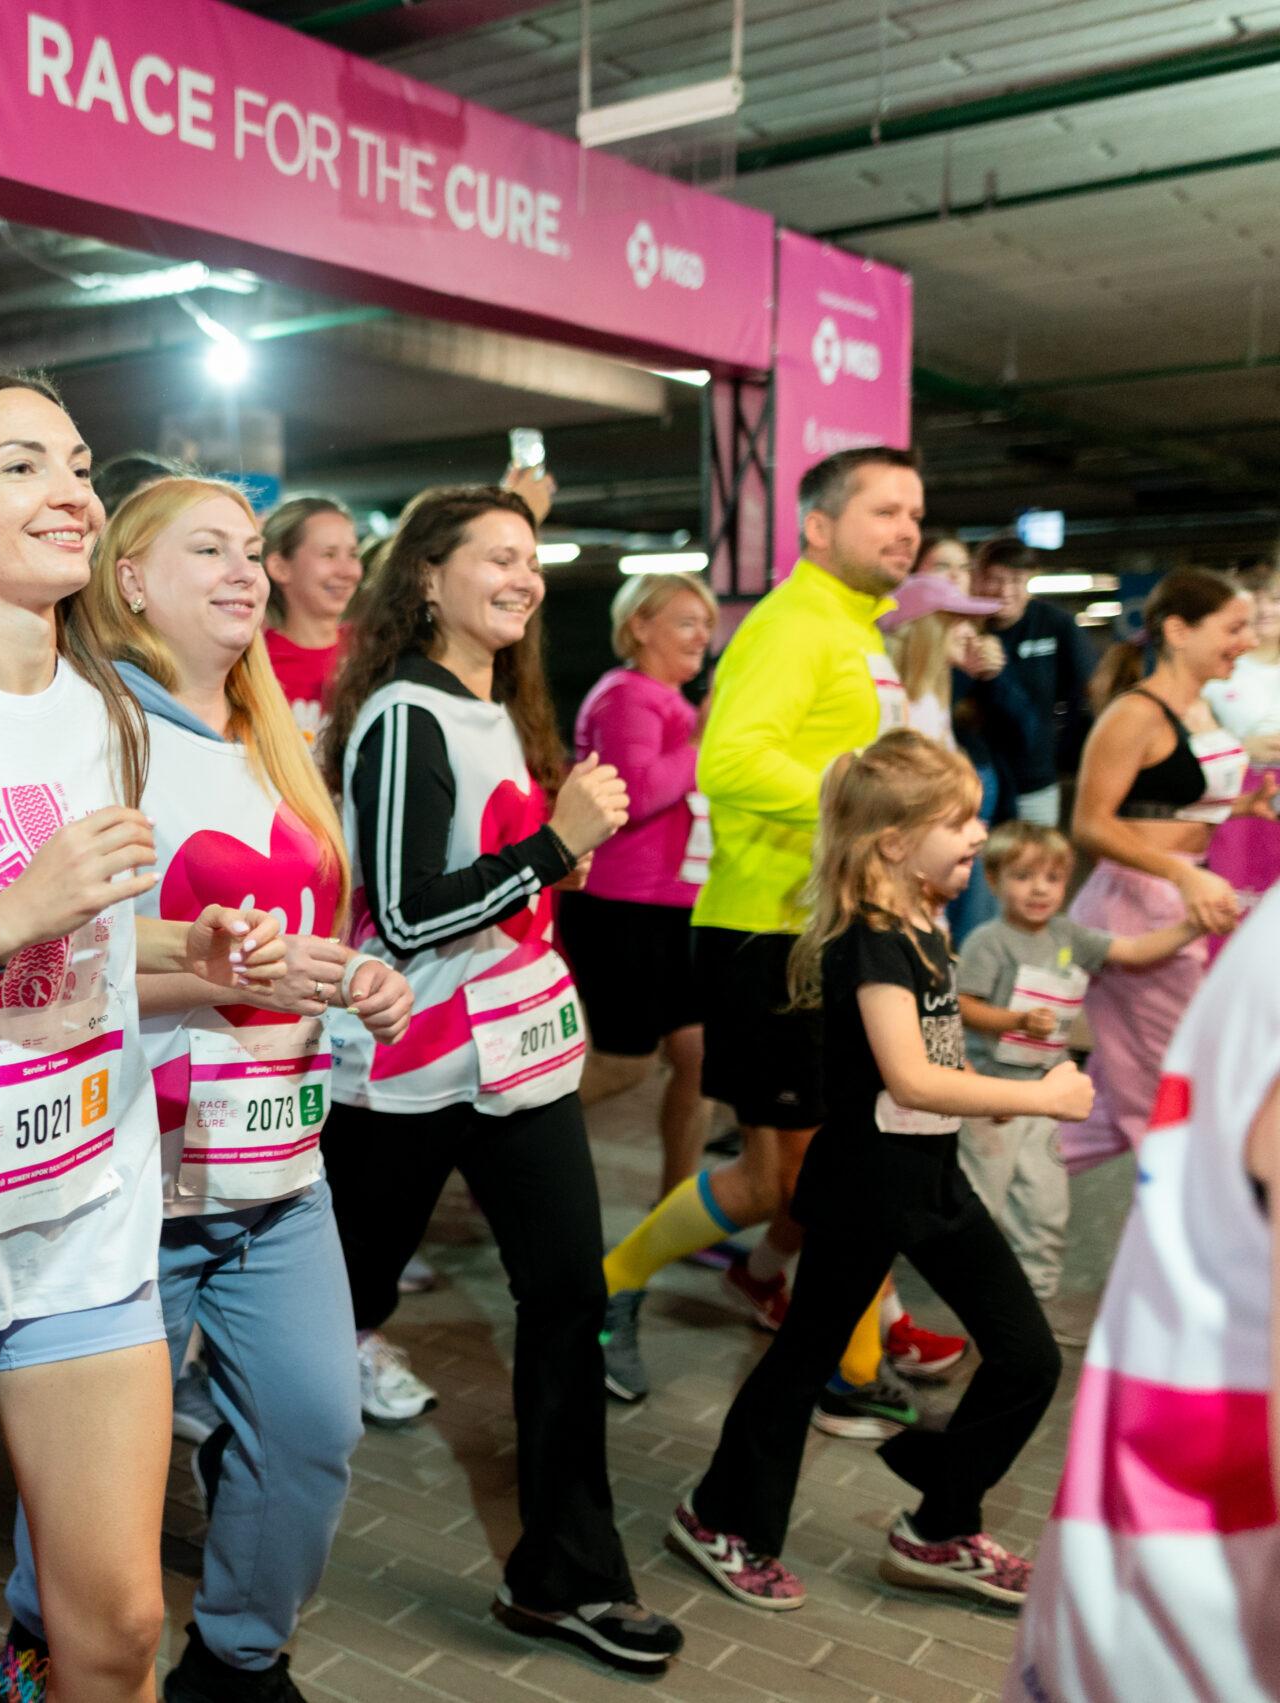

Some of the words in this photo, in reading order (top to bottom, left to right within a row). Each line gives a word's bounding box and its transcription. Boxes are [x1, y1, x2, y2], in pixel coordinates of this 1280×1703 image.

[27, 13, 216, 151] RACE
[233, 87, 342, 190] FOR
[347, 126, 437, 219] THE
[564, 1005, 572, 1025] 2
[521, 1020, 555, 1056] 2071
[90, 1077, 100, 1100] 5
[306, 1088, 316, 1107] 2
[199, 1100, 228, 1109] RACE
[246, 1096, 294, 1132] 2073
[16, 1094, 71, 1150] 5021
[197, 1119, 226, 1128] CURE
